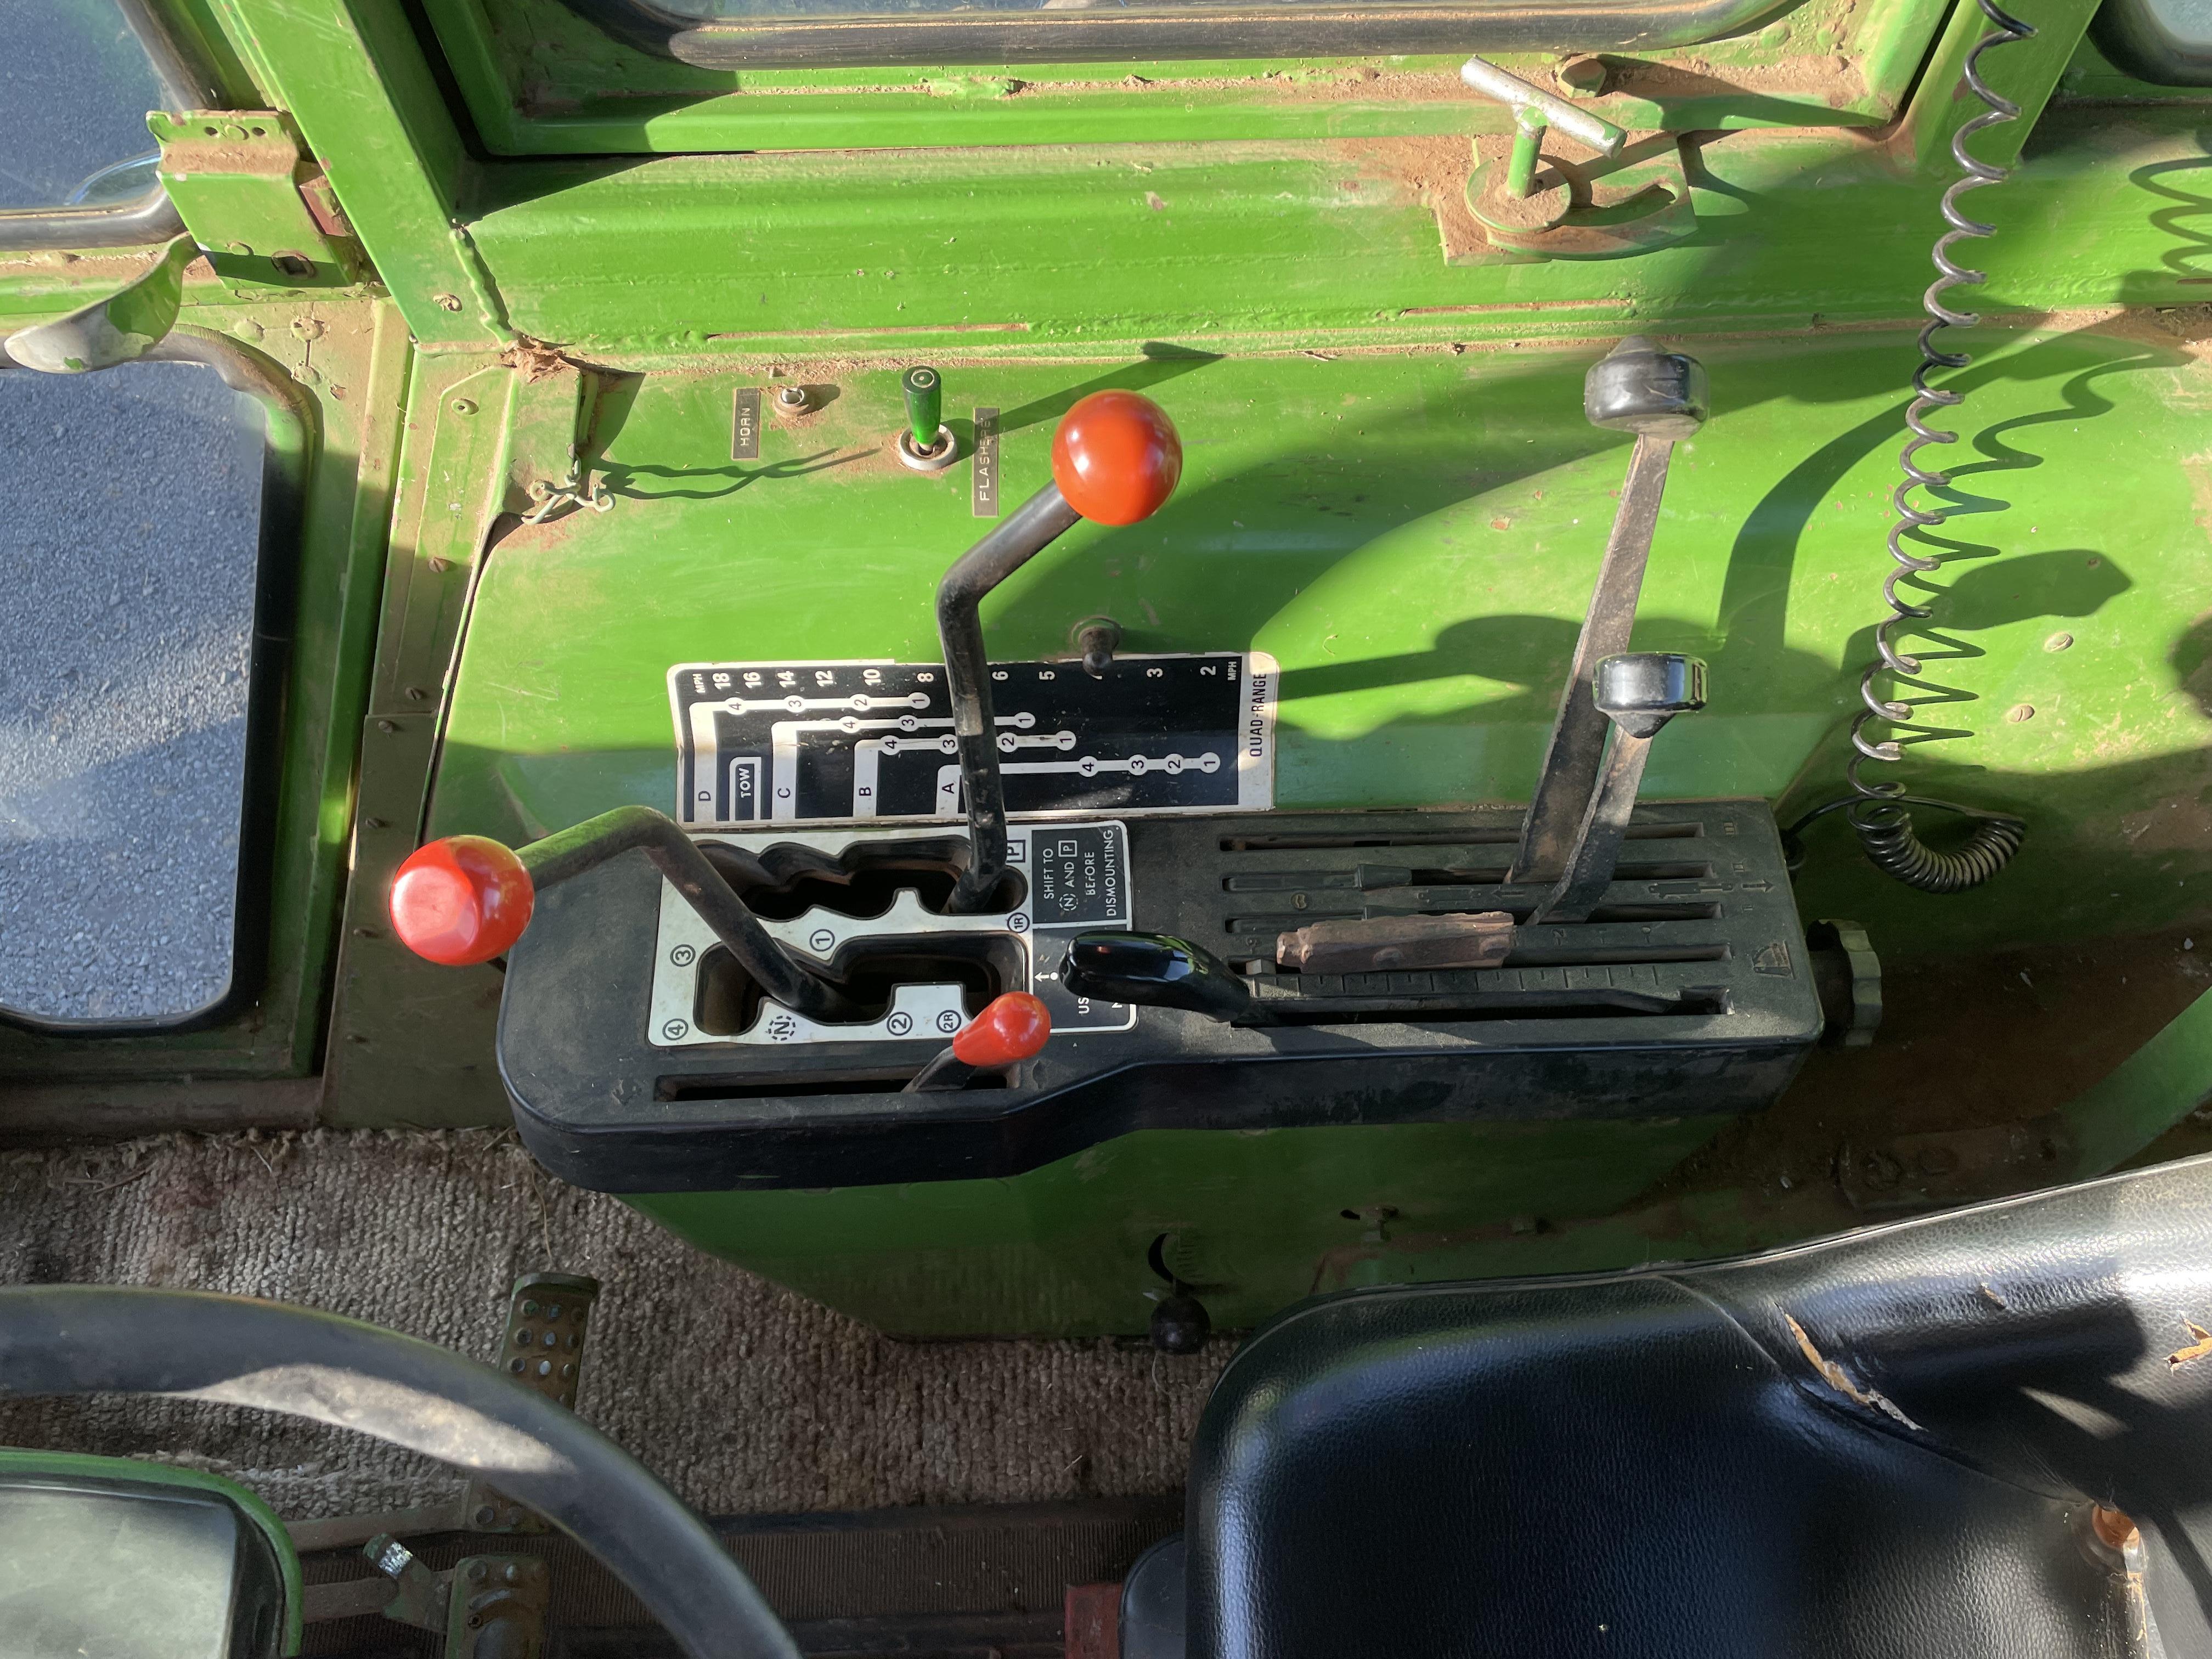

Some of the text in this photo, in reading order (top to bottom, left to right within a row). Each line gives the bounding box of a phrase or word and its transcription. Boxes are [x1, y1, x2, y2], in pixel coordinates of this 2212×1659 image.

[740, 408, 750, 445] HORN
[992, 672, 1008, 680] 6
[1039, 671, 1055, 680] 5
[1147, 668, 1163, 677] 3
[1200, 666, 1216, 675] 2
[1228, 662, 1237, 680] MPH
[713, 673, 731, 689] 18
[743, 672, 761, 688] 16
[779, 671, 795, 687] 14
[815, 670, 833, 686] 12
[863, 669, 881, 685] 10
[917, 673, 934, 682] 8
[693, 674, 706, 693] MPH
[1250, 674, 1266, 757] QUAD-RANGE
[885, 740, 897, 749] 4
[943, 740, 955, 748] 3
[1002, 737, 1014, 746] 2
[1082, 763, 1094, 772] 4
[1131, 760, 1144, 769] 3
[1168, 760, 1180, 768] 2
[739, 768, 751, 798] TOW
[942, 783, 954, 794] A
[698, 791, 710, 801] D
[777, 788, 790, 798] C
[859, 787, 871, 795] B
[1043, 849, 1054, 899] SHIFT TO
[1064, 862, 1074, 887] AND
[1085, 852, 1096, 895] BEFORE
[1103, 830, 1116, 916] DISMOUNTING
[1015, 918, 1023, 929] 1R
[675, 950, 691, 960] 3
[891, 1017, 906, 1029] 2
[944, 1014, 953, 1029] 2R
[668, 1024, 684, 1036] 4
[774, 1022, 789, 1034] N
